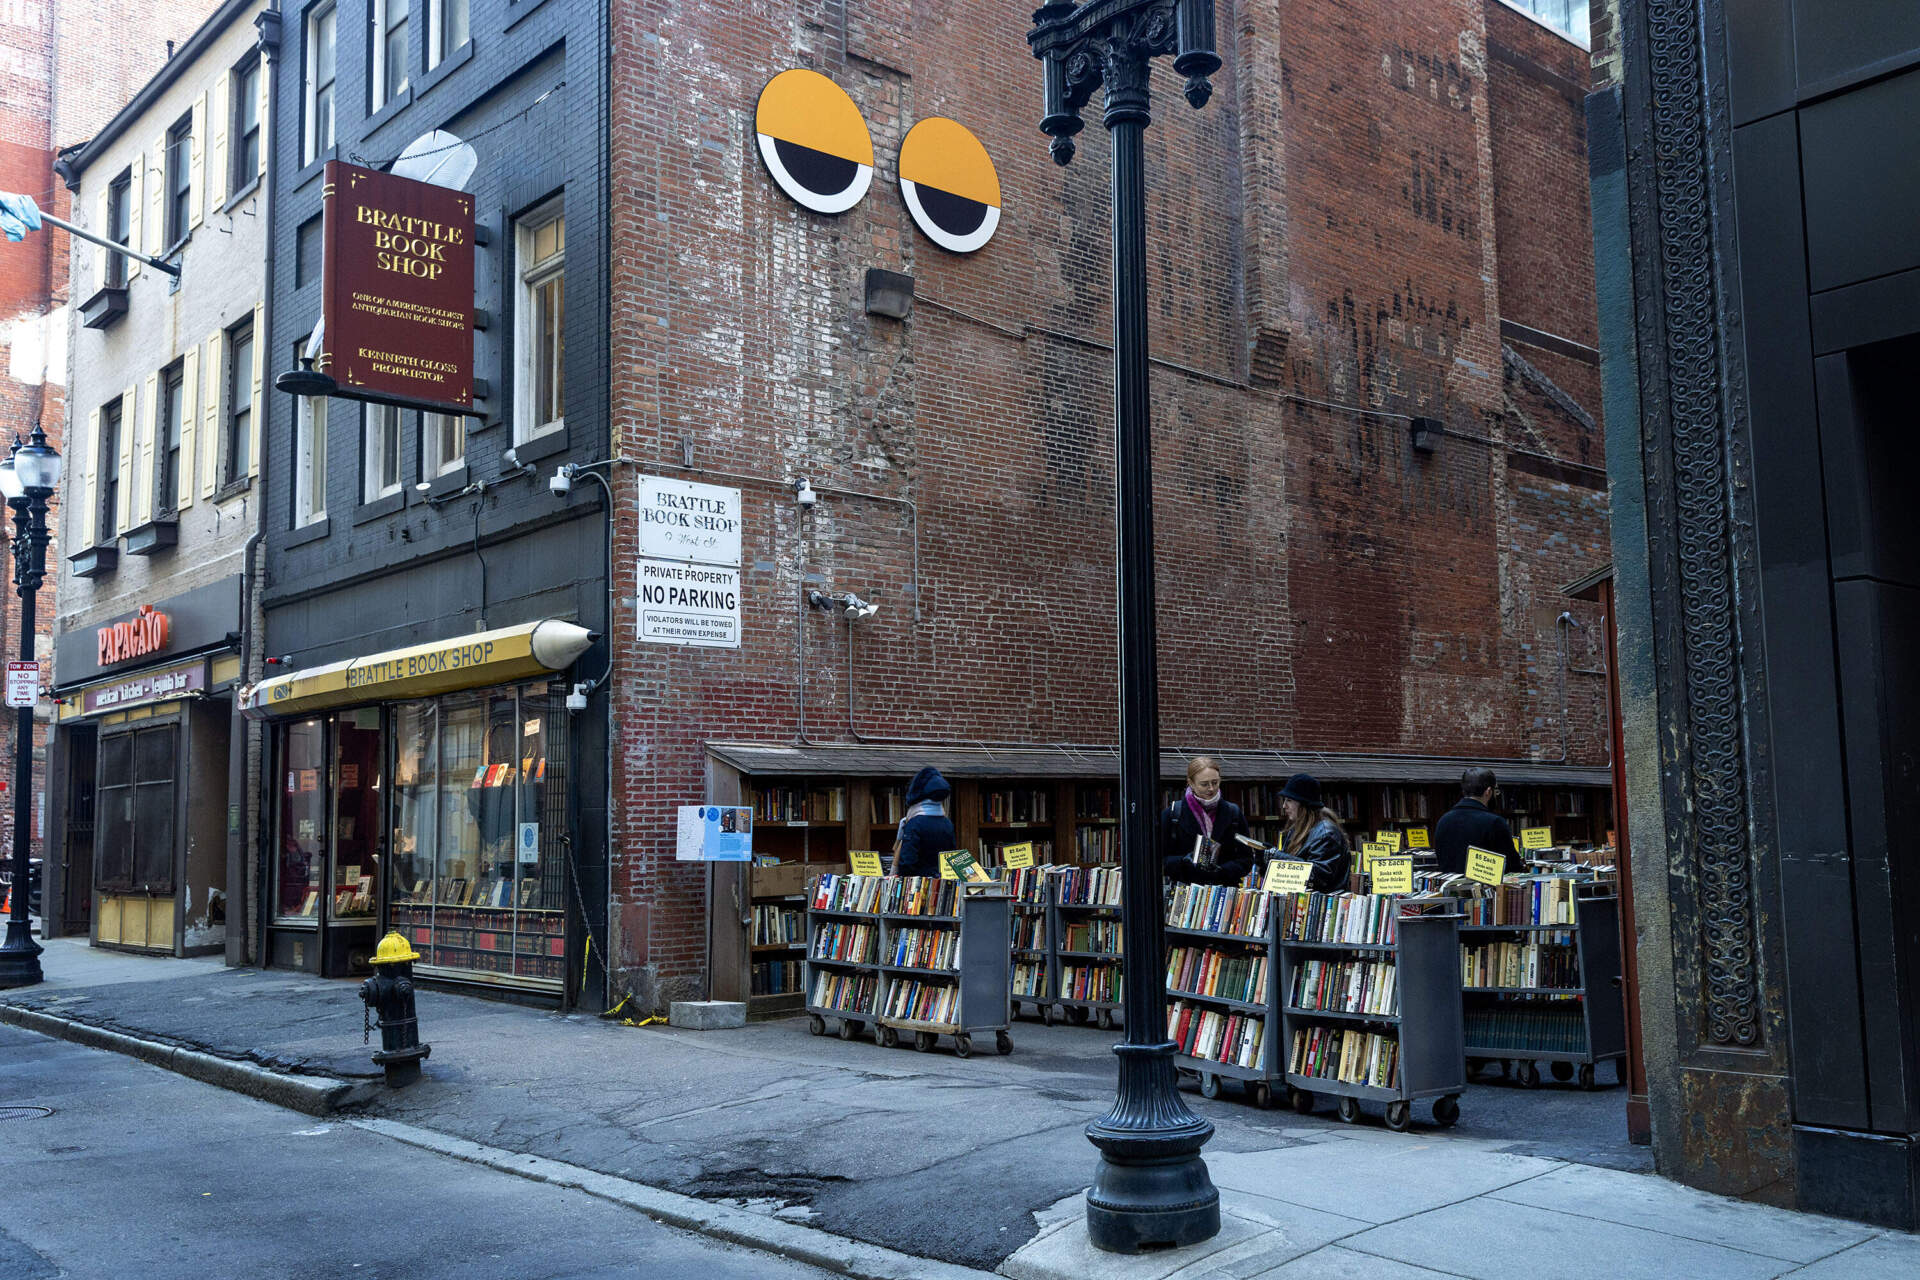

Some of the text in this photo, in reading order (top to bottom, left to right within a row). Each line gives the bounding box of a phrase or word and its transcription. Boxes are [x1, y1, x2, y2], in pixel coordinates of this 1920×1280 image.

[357, 205, 464, 246] BRATTLE
[375, 230, 447, 262] BOOK
[377, 251, 443, 281] SHOP
[351, 301, 465, 330] ANTIQUARIAN BOOK SHOPS
[352, 291, 464, 321] ONE OF AMERICA'S OLDEST
[358, 347, 458, 374] KENNETH GLOSS
[372, 361, 445, 383] PROPRIETOR
[656, 492, 726, 516] BRATTLE
[643, 507, 738, 533] BOOK SHOP
[644, 565, 733, 585] PRIVATE PROPERTY
[643, 584, 736, 611] NO PARKING
[646, 614, 733, 629] VIOLATORS WILL BE TOWED
[652, 626, 661, 634] AT
[662, 627, 681, 635] THEIR
[698, 630, 727, 639] EXPENSE
[17, 672, 30, 680] NO
[349, 641, 494, 688] BRATTLE BOOK SHOP
[1276, 862, 1305, 871] $5 Each
[1483, 855, 1497, 865] Each
